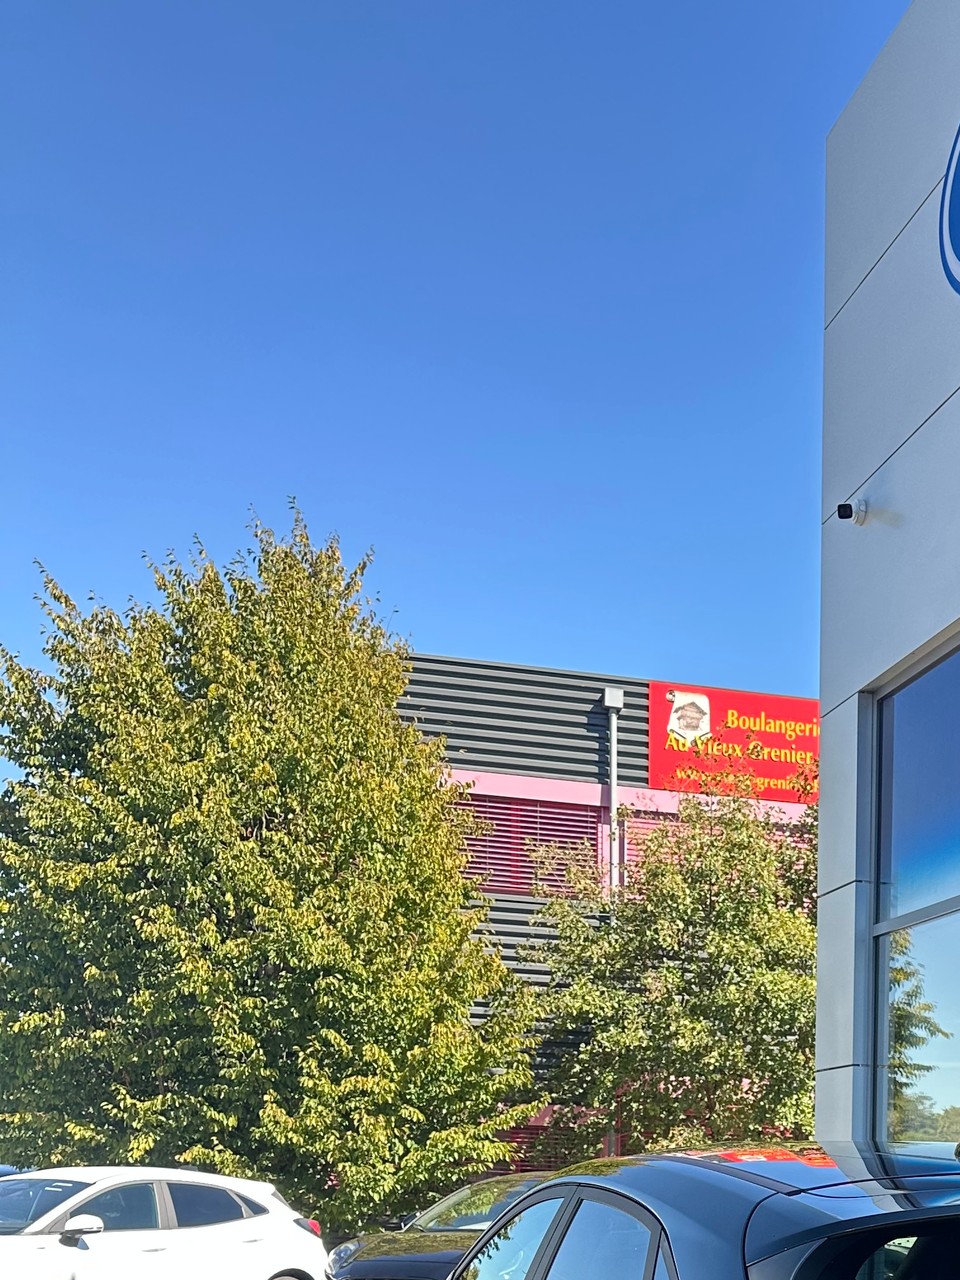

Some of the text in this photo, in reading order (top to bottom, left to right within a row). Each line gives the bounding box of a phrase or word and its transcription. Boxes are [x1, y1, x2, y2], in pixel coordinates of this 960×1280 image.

[727, 709, 820, 741] Boulangeri
[665, 731, 689, 752] Au
[747, 741, 814, 765] Grenier
